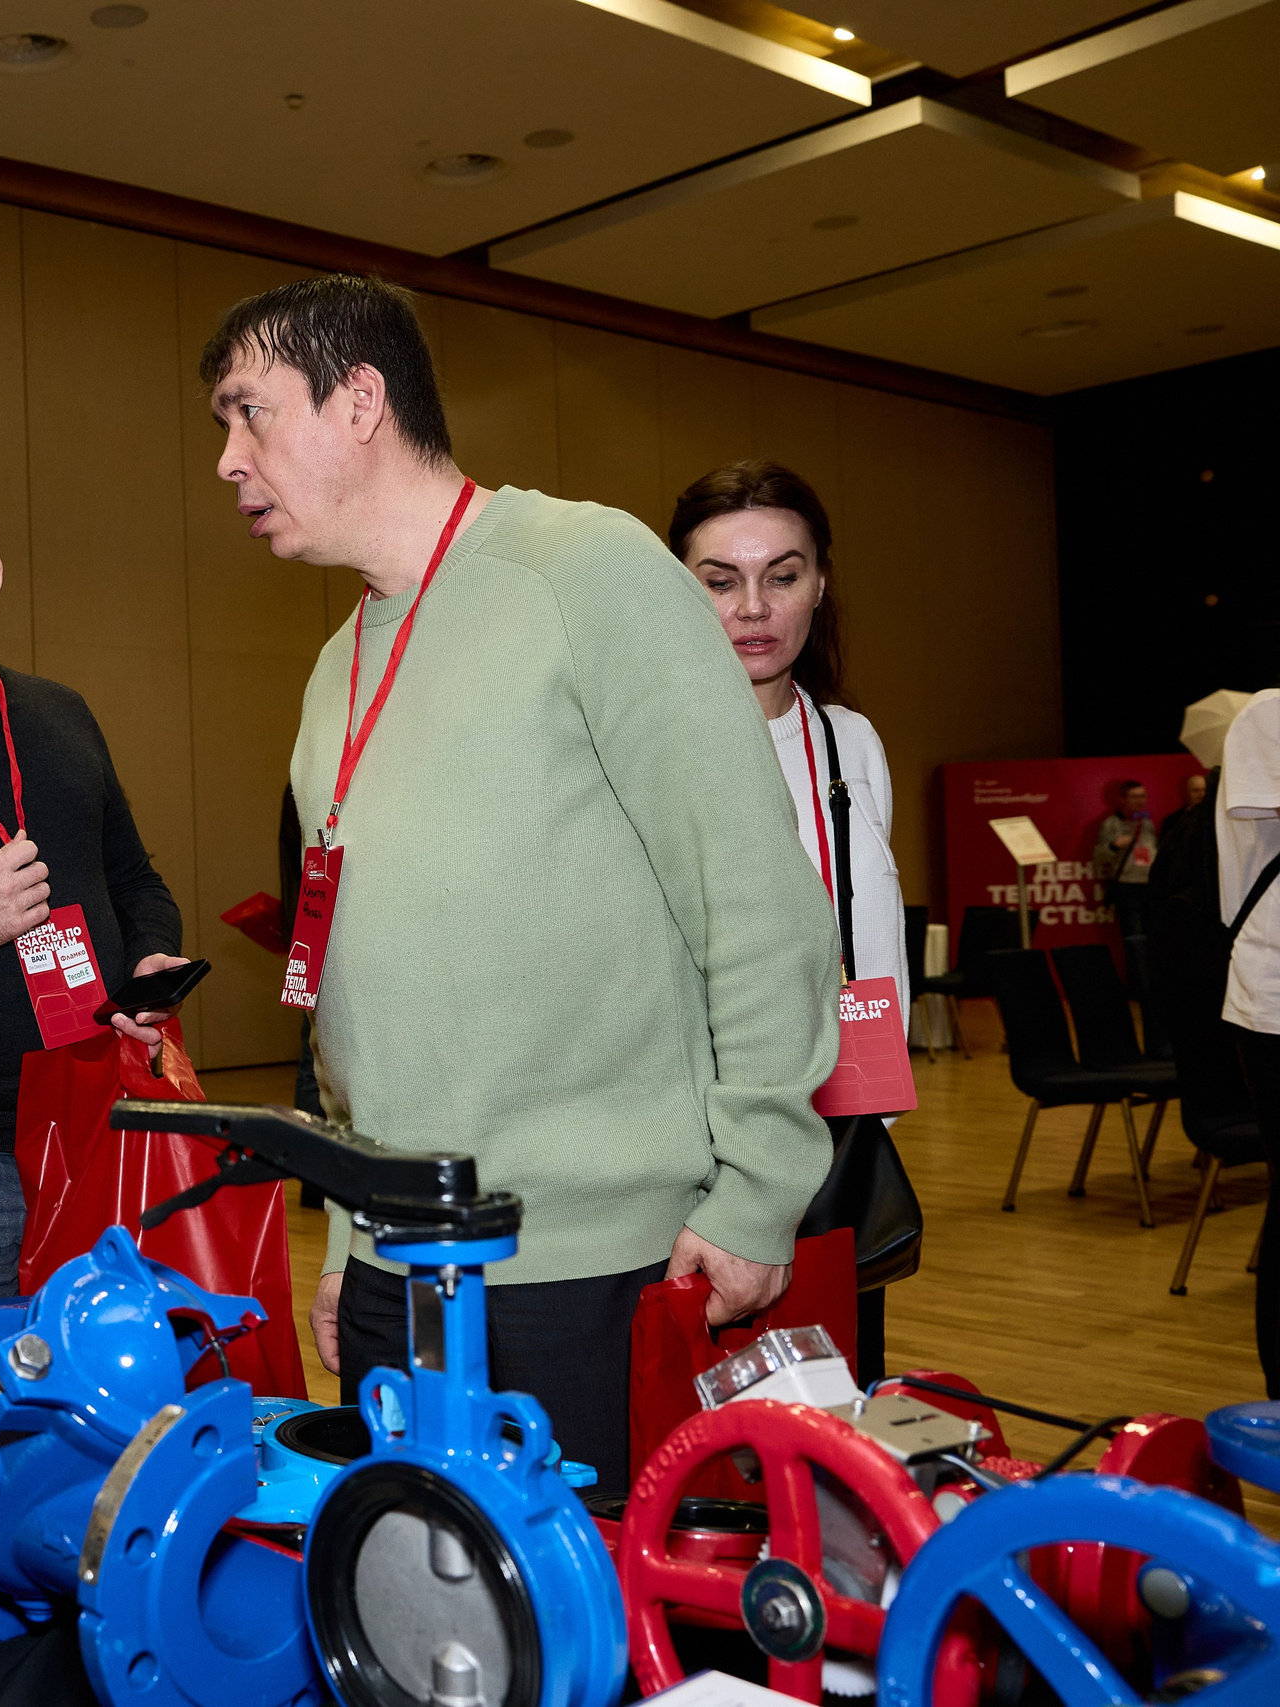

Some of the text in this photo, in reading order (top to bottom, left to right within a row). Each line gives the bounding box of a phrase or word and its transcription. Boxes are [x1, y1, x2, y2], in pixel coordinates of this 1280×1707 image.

[17, 926, 82, 949] СЧАСТЬЕ ПО
[19, 936, 78, 959] КУСОЧКАМ
[31, 953, 48, 963] BAXI
[286, 958, 307, 975] ДЕНЬ
[285, 974, 307, 991] ТЕПЛА
[281, 988, 317, 1008] И СЧАСТЬЯ
[868, 998, 890, 1009] ПО
[839, 1009, 882, 1021] ЧКАМ
